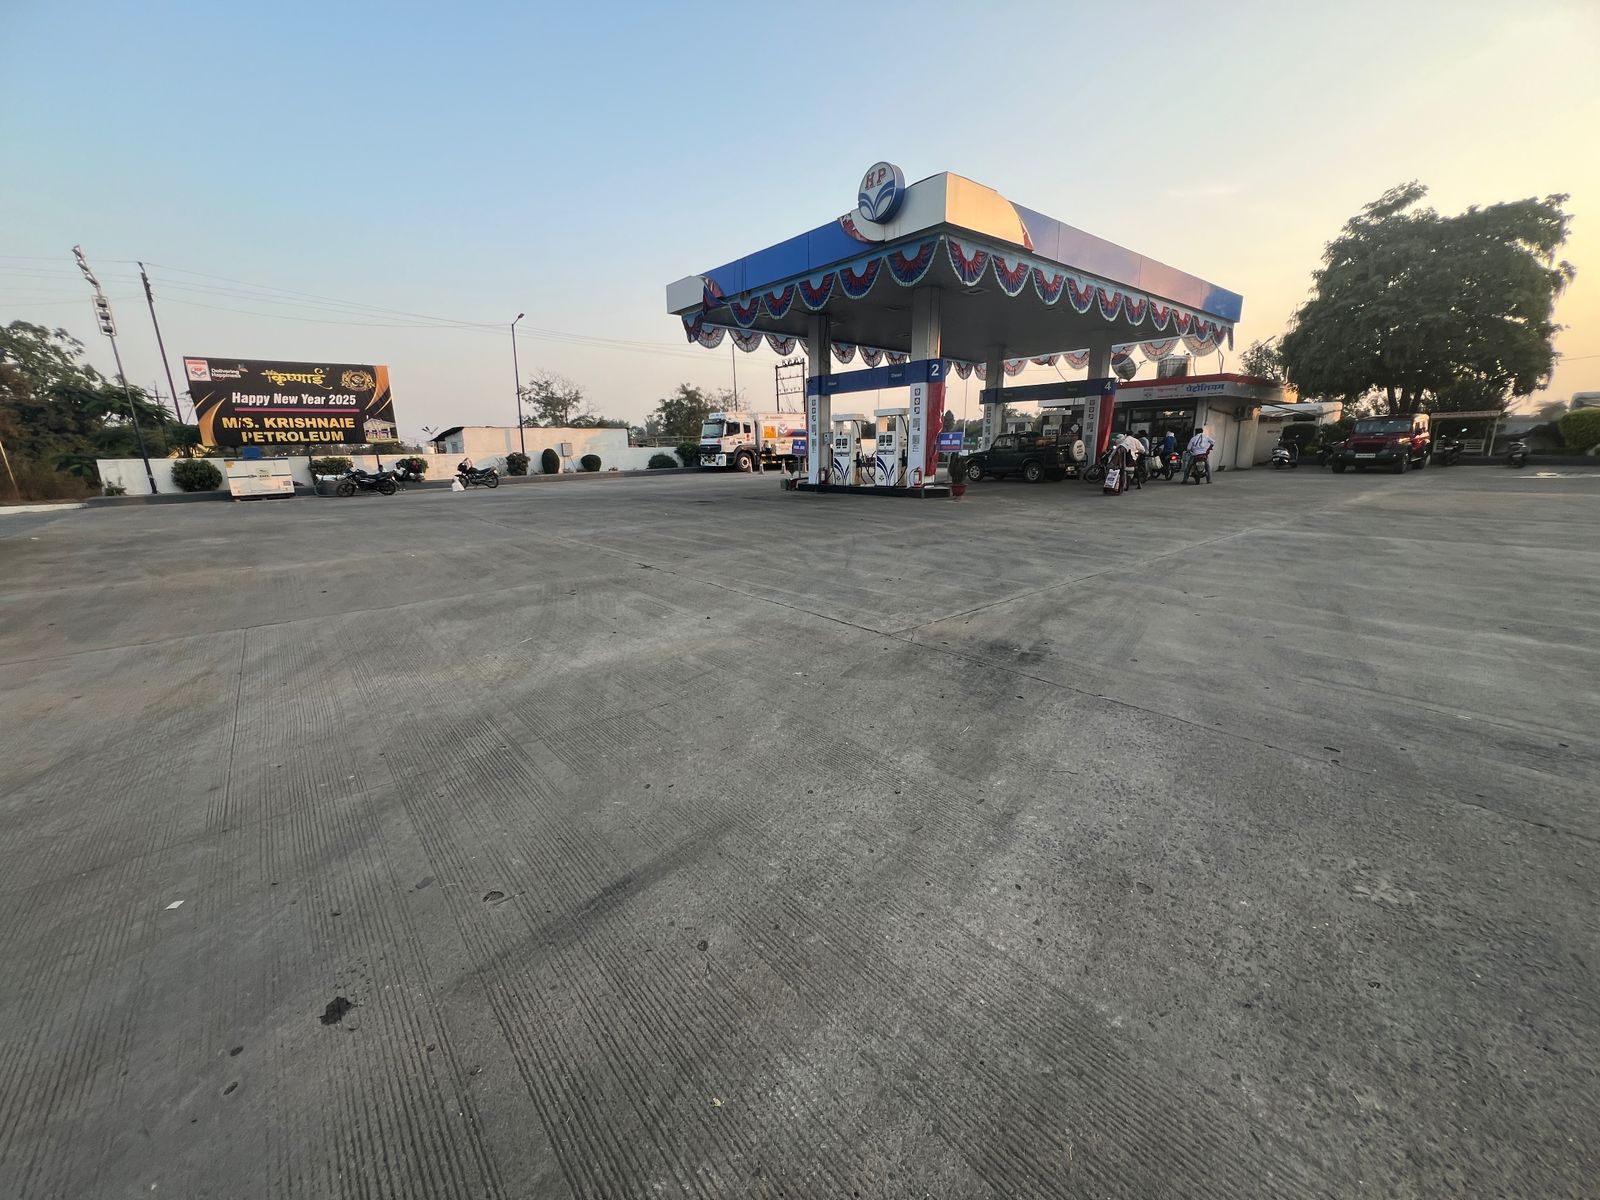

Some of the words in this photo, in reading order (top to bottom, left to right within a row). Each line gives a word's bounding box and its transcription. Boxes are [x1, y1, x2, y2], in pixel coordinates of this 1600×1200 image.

[865, 167, 887, 191] HP
[931, 363, 939, 376] 2
[1104, 382, 1113, 391] 4
[232, 392, 271, 407] Happy
[273, 393, 299, 405] New
[301, 394, 326, 405] Year
[328, 394, 356, 405] 2025
[264, 418, 355, 429] KRISHNAIE
